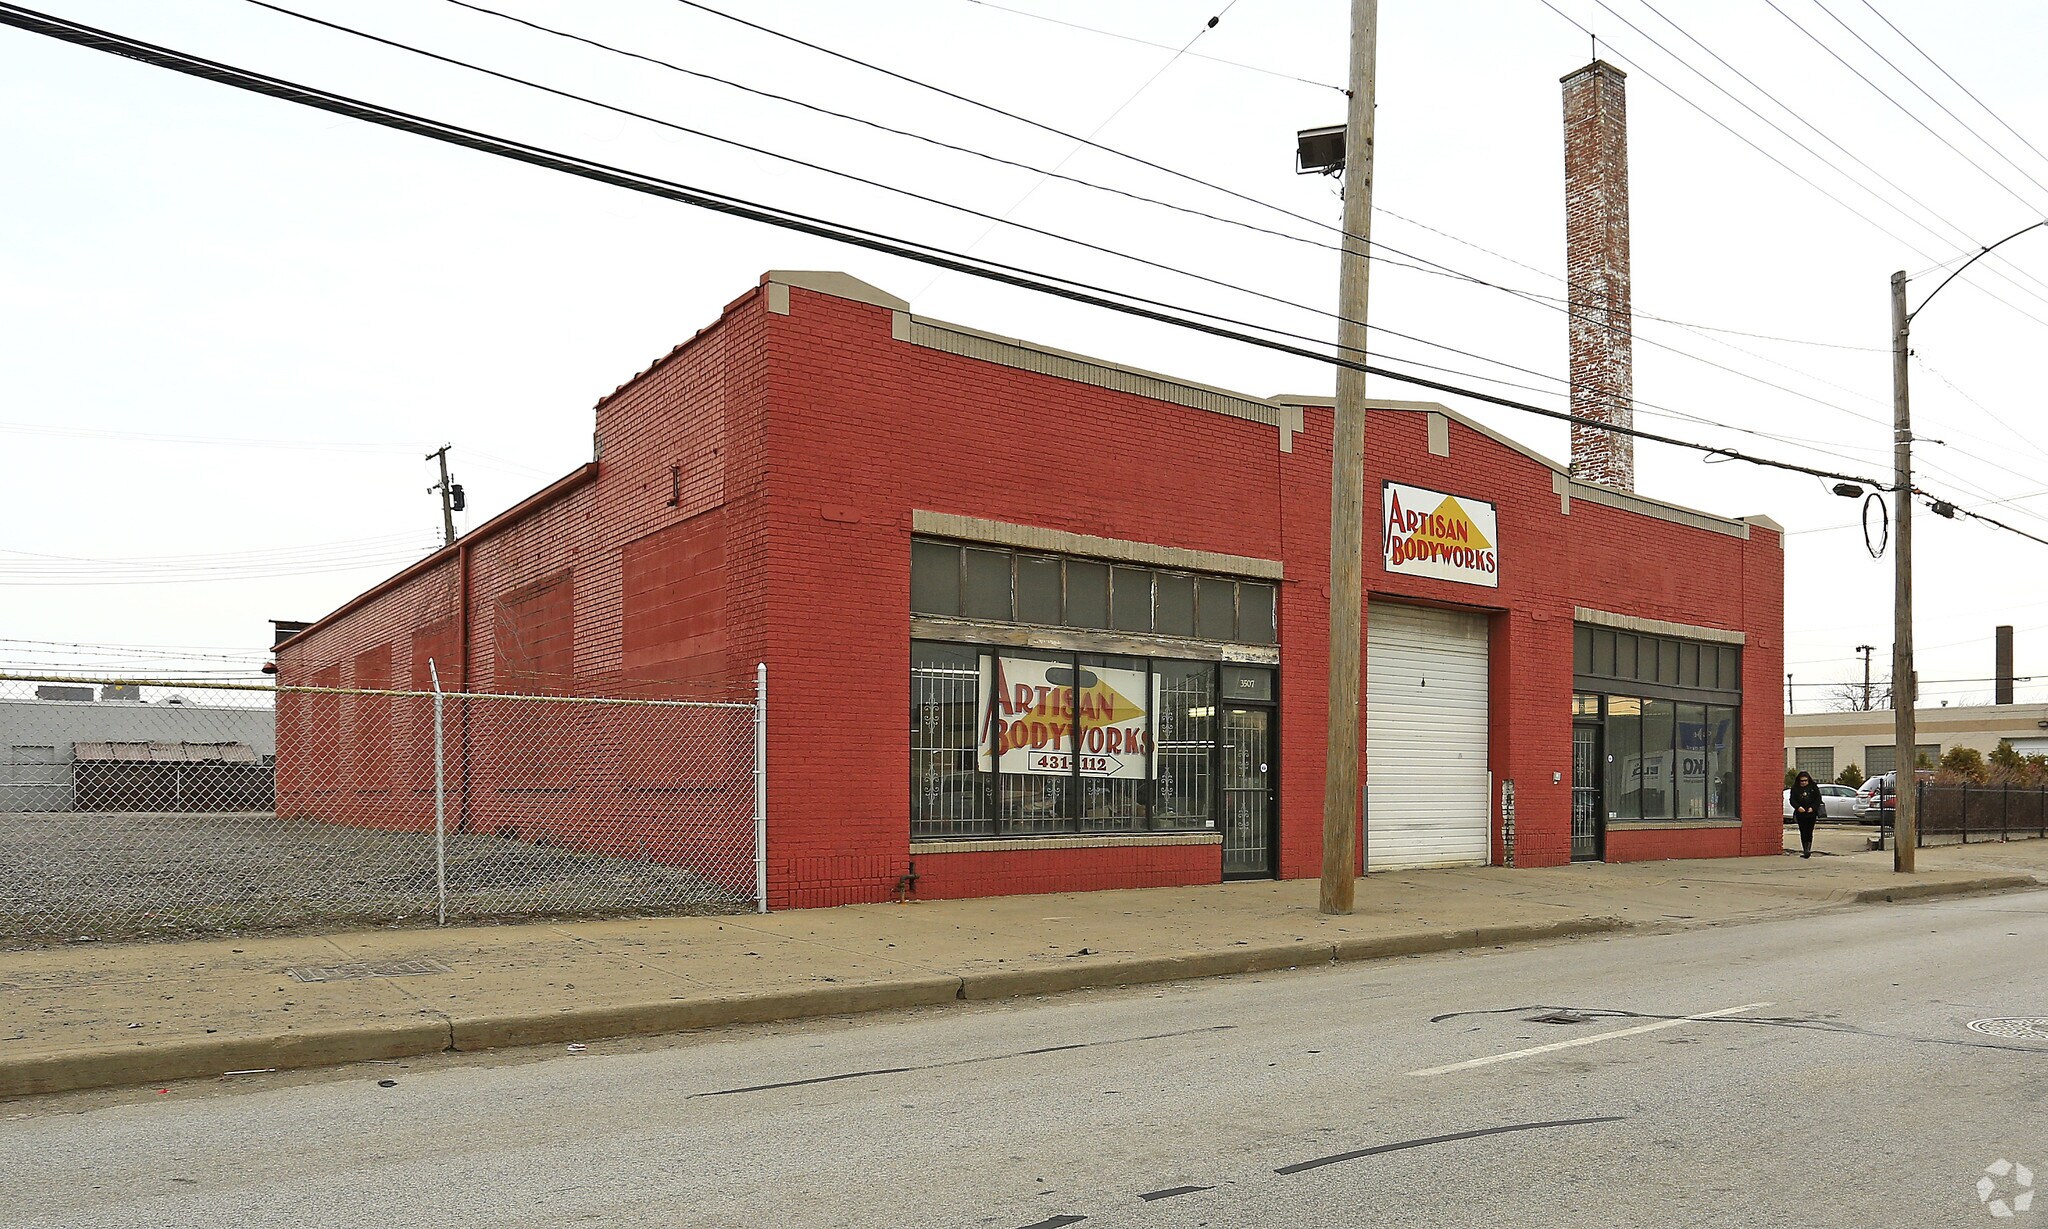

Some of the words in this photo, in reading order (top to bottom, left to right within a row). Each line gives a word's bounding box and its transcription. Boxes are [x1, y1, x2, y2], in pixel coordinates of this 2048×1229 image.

[1386, 489, 1468, 553] ARTISAN
[1392, 535, 1496, 573] BODYWORKS
[1240, 680, 1255, 688] 3507
[1037, 755, 1107, 771] 431-112
